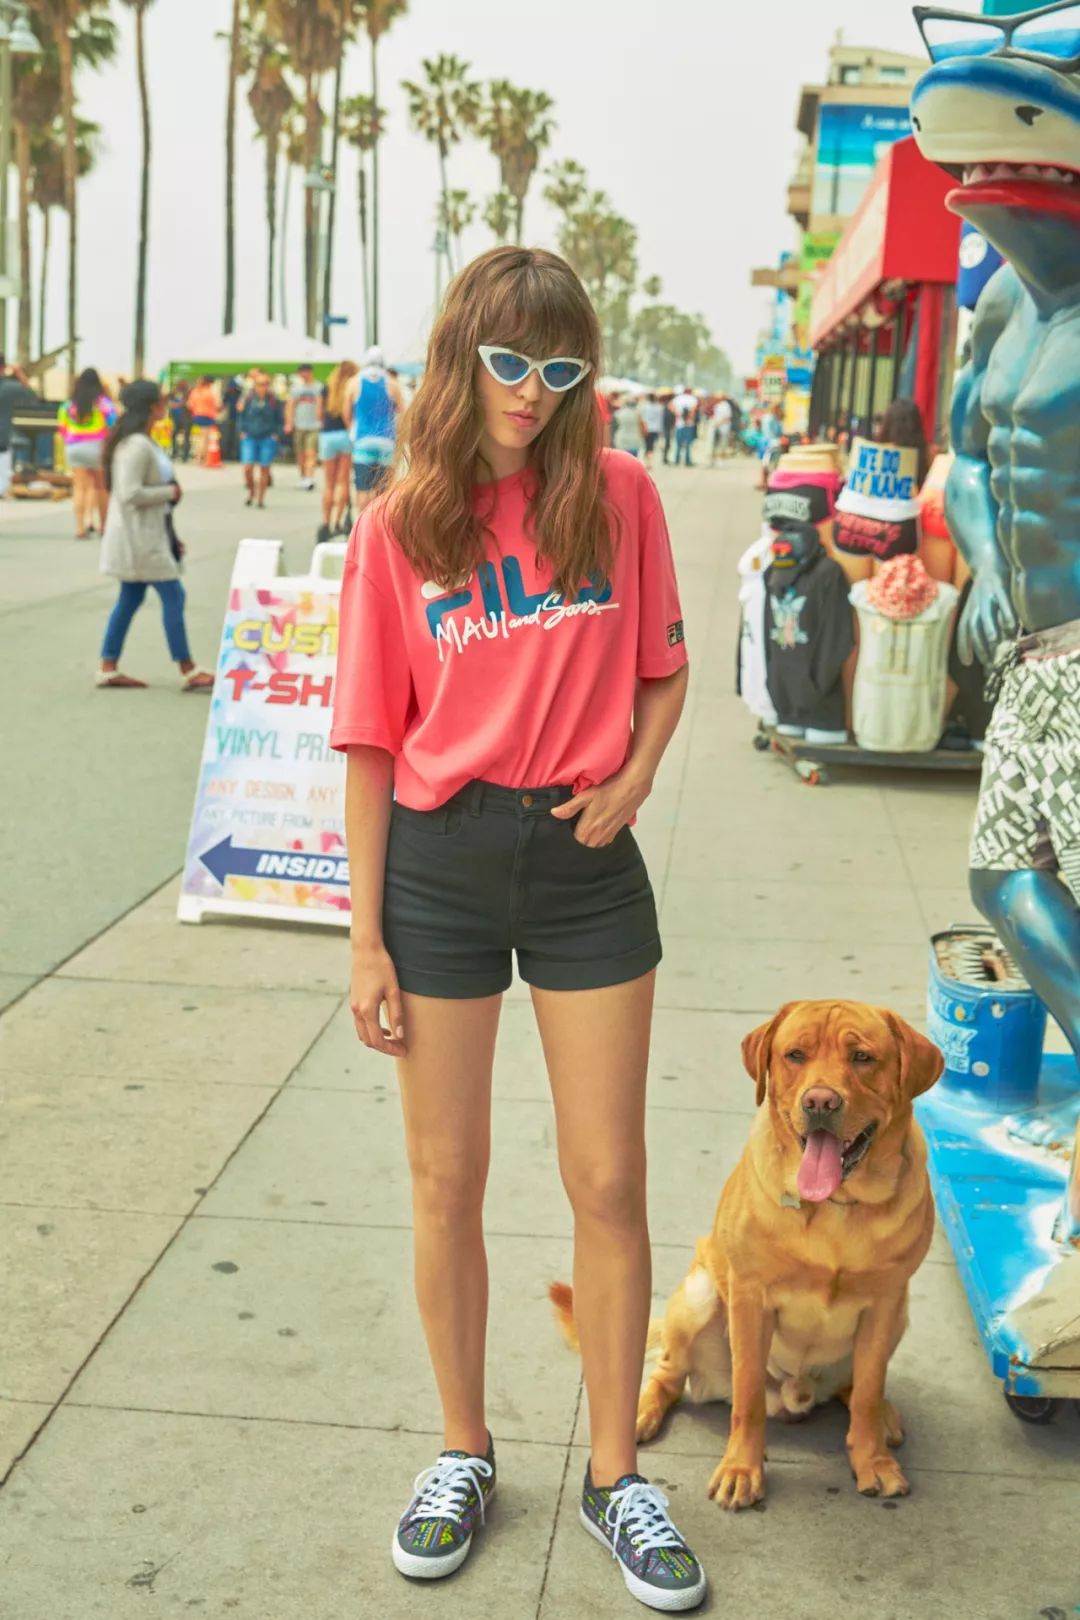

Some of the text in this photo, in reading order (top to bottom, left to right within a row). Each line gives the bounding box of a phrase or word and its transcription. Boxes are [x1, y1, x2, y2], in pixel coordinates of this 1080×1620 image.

[435, 611, 510, 662] MAUI
[508, 604, 542, 630] and
[224, 668, 334, 707] T-SH
[216, 726, 283, 760] VINYL
[207, 779, 239, 796] ANY
[307, 785, 339, 805] ANY
[256, 854, 350, 880] INSIDE
